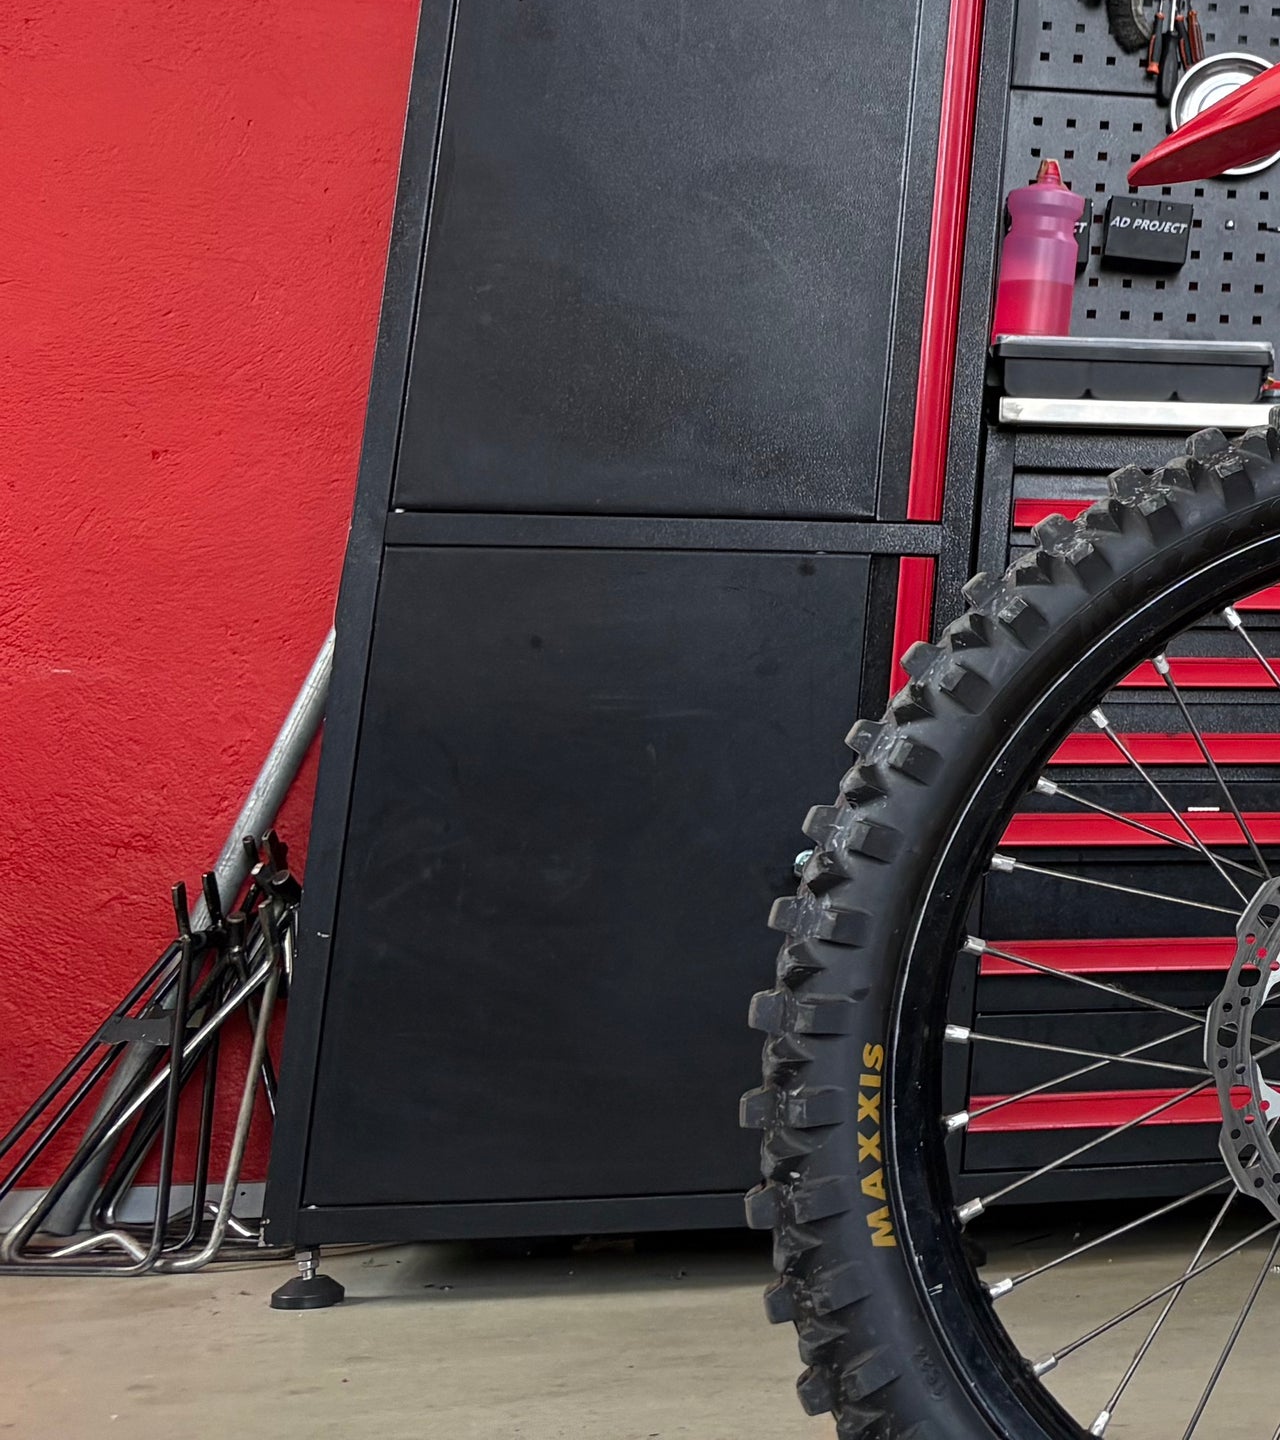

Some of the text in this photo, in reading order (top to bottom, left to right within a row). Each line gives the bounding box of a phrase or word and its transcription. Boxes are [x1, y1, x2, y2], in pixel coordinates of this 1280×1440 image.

[1110, 216, 1188, 235] AD PROJECT
[857, 1042, 898, 1248] MAXXIS
